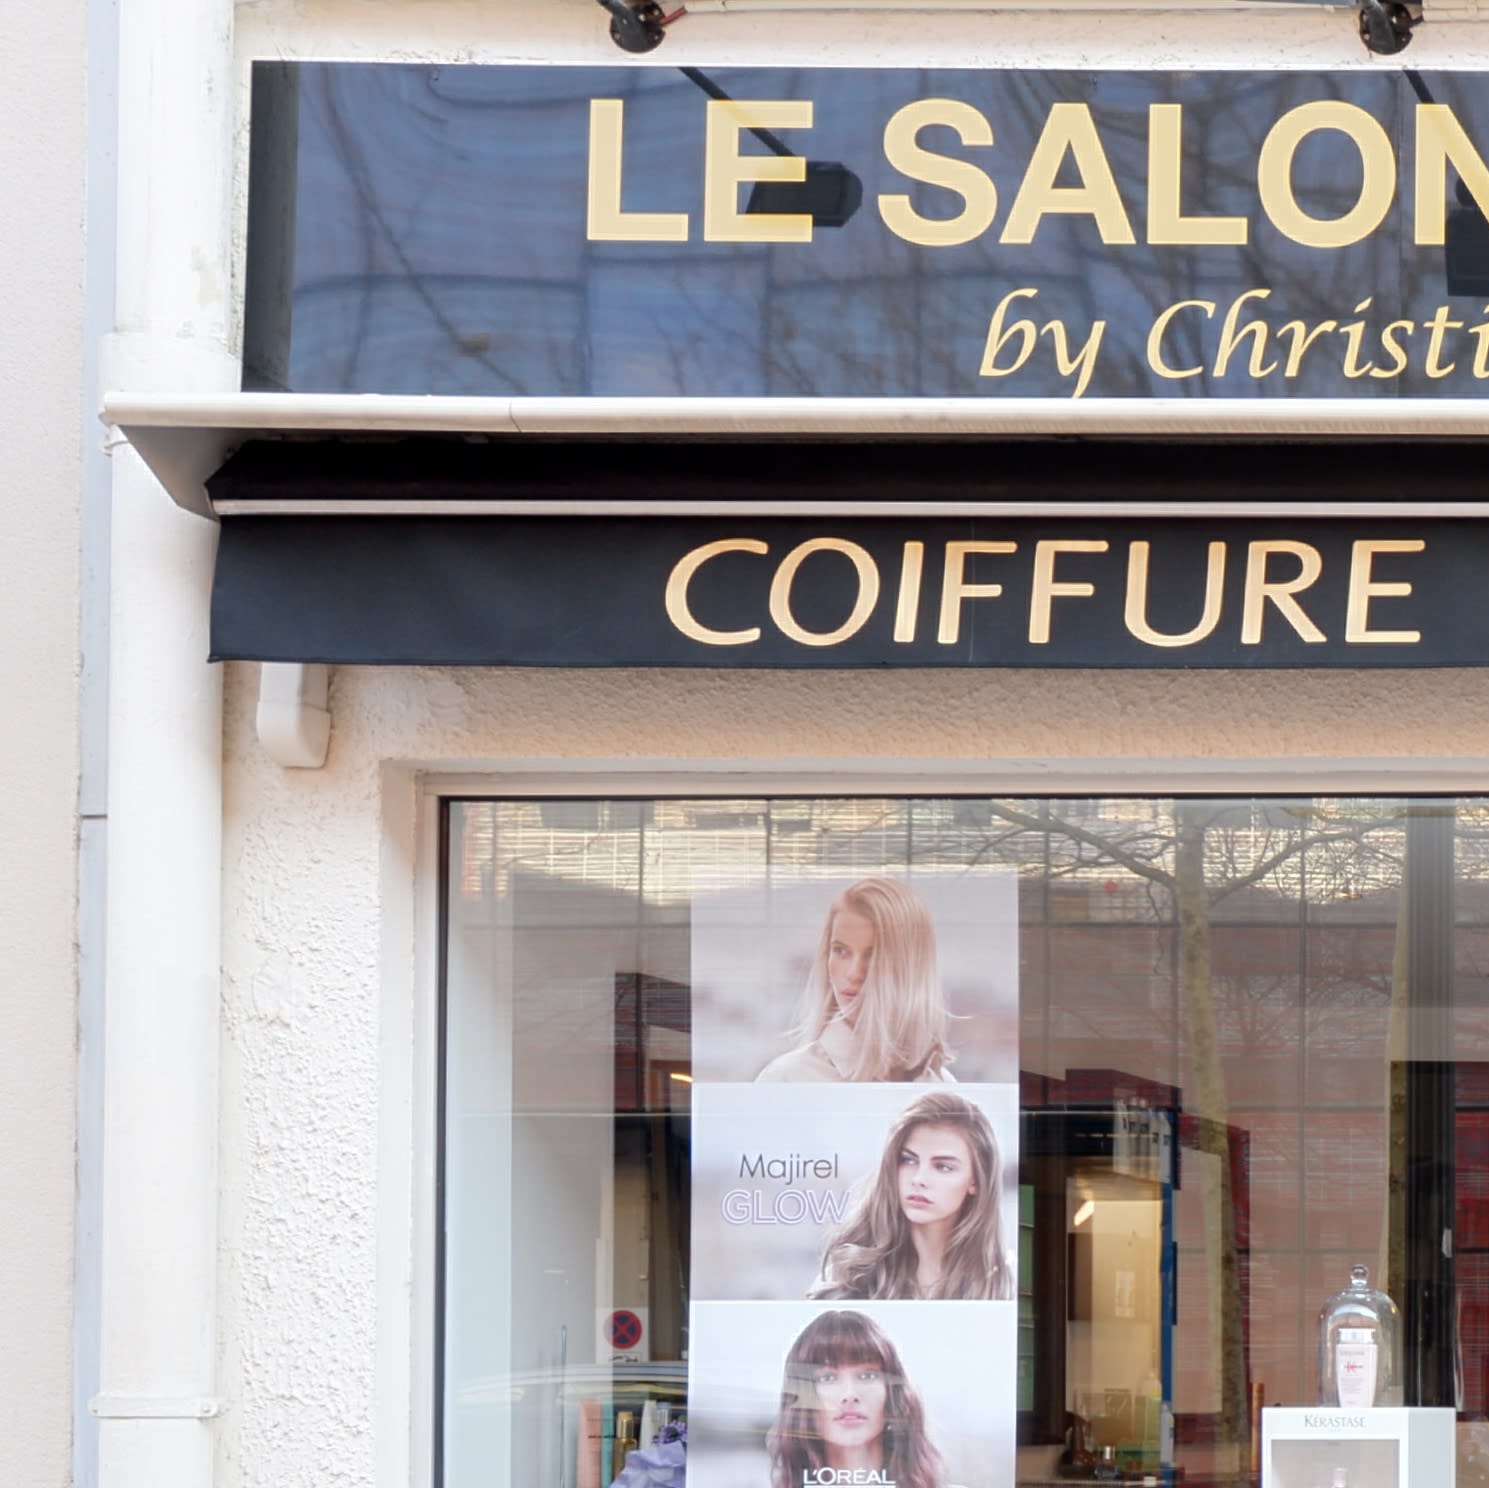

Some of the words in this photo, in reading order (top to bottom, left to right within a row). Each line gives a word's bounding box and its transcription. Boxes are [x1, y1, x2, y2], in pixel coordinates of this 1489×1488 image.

[587, 98, 813, 243] LE
[979, 288, 1105, 398] by
[665, 536, 1426, 648] COIFFURE
[722, 1189, 852, 1224] GLOW
[739, 1153, 838, 1185] Majirel
